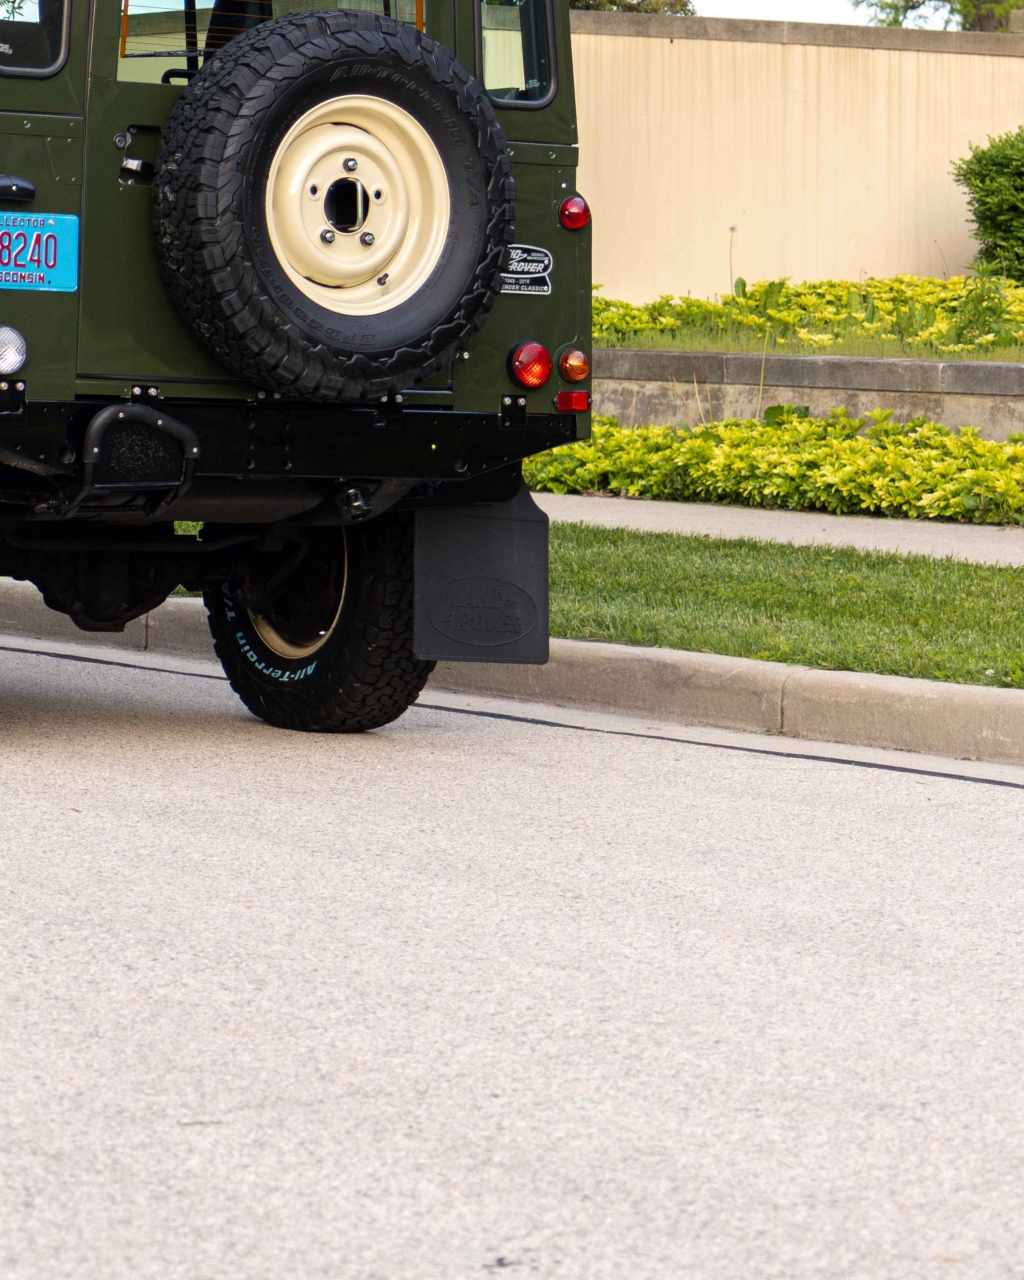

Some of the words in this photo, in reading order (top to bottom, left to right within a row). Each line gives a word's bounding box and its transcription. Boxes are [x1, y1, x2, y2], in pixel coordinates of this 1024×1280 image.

[508, 262, 544, 272] ROVER
[449, 586, 502, 609] LAND
[449, 610, 525, 633] ROVER
[235, 630, 318, 682] All-Terrain
